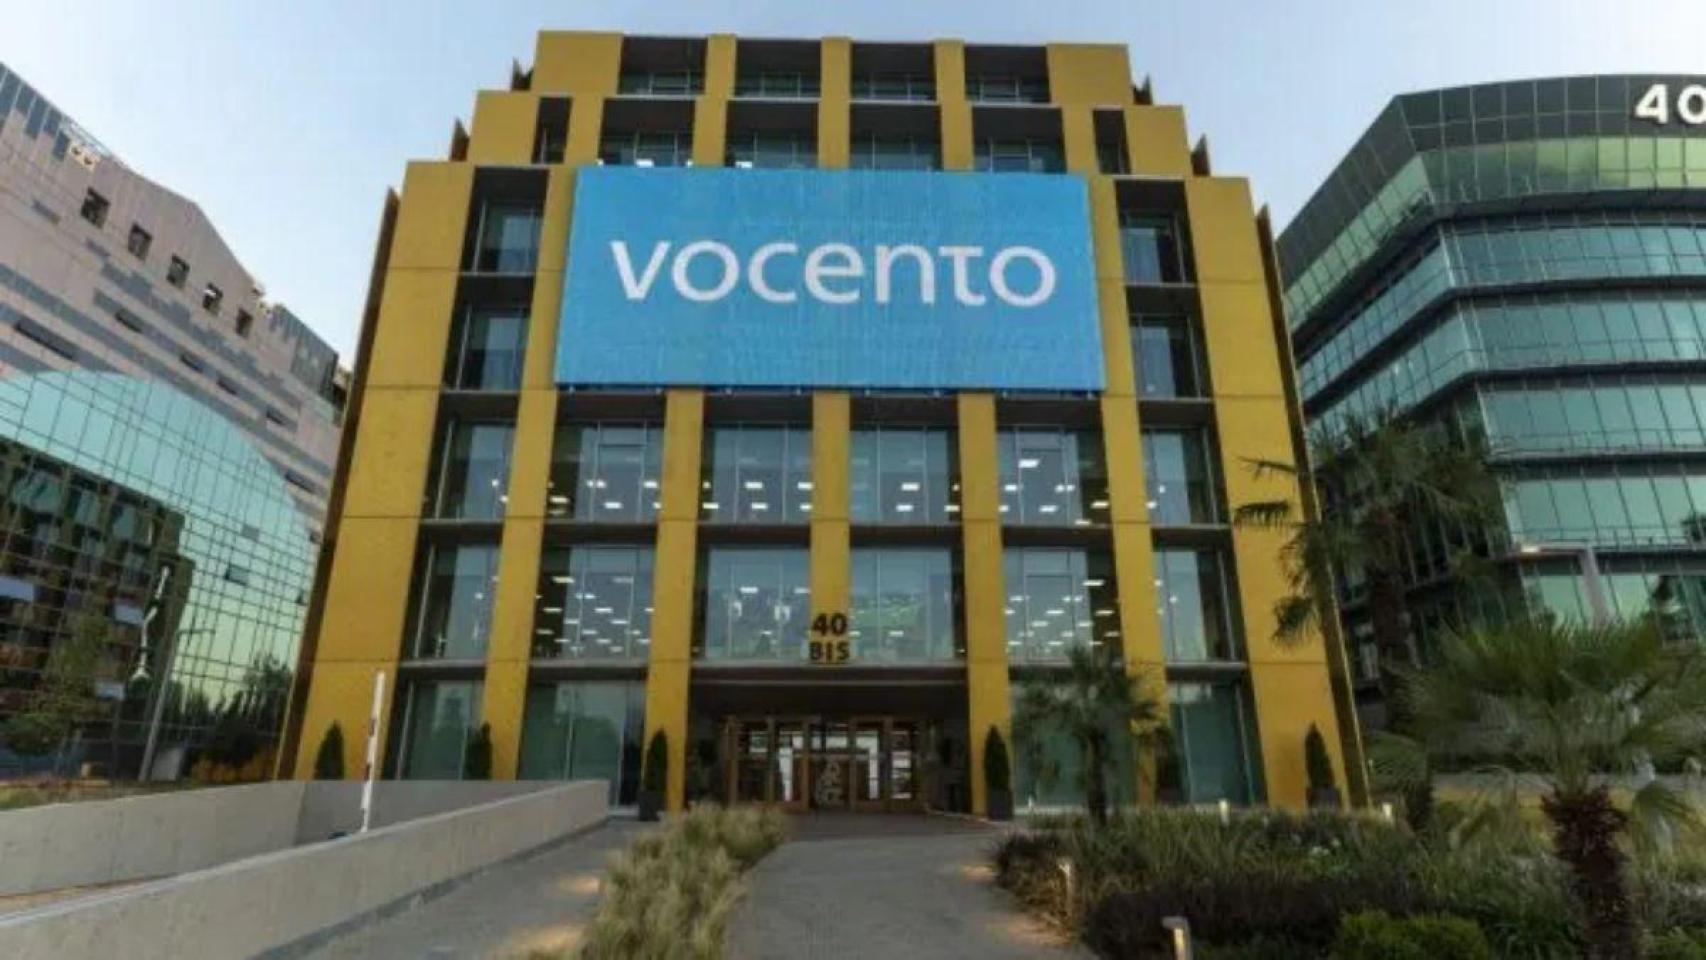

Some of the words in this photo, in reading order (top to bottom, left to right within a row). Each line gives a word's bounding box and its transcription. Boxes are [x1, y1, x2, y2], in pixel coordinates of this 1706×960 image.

[1635, 84, 1706, 124] 40
[812, 612, 848, 637] 40
[808, 641, 849, 661] BIS
